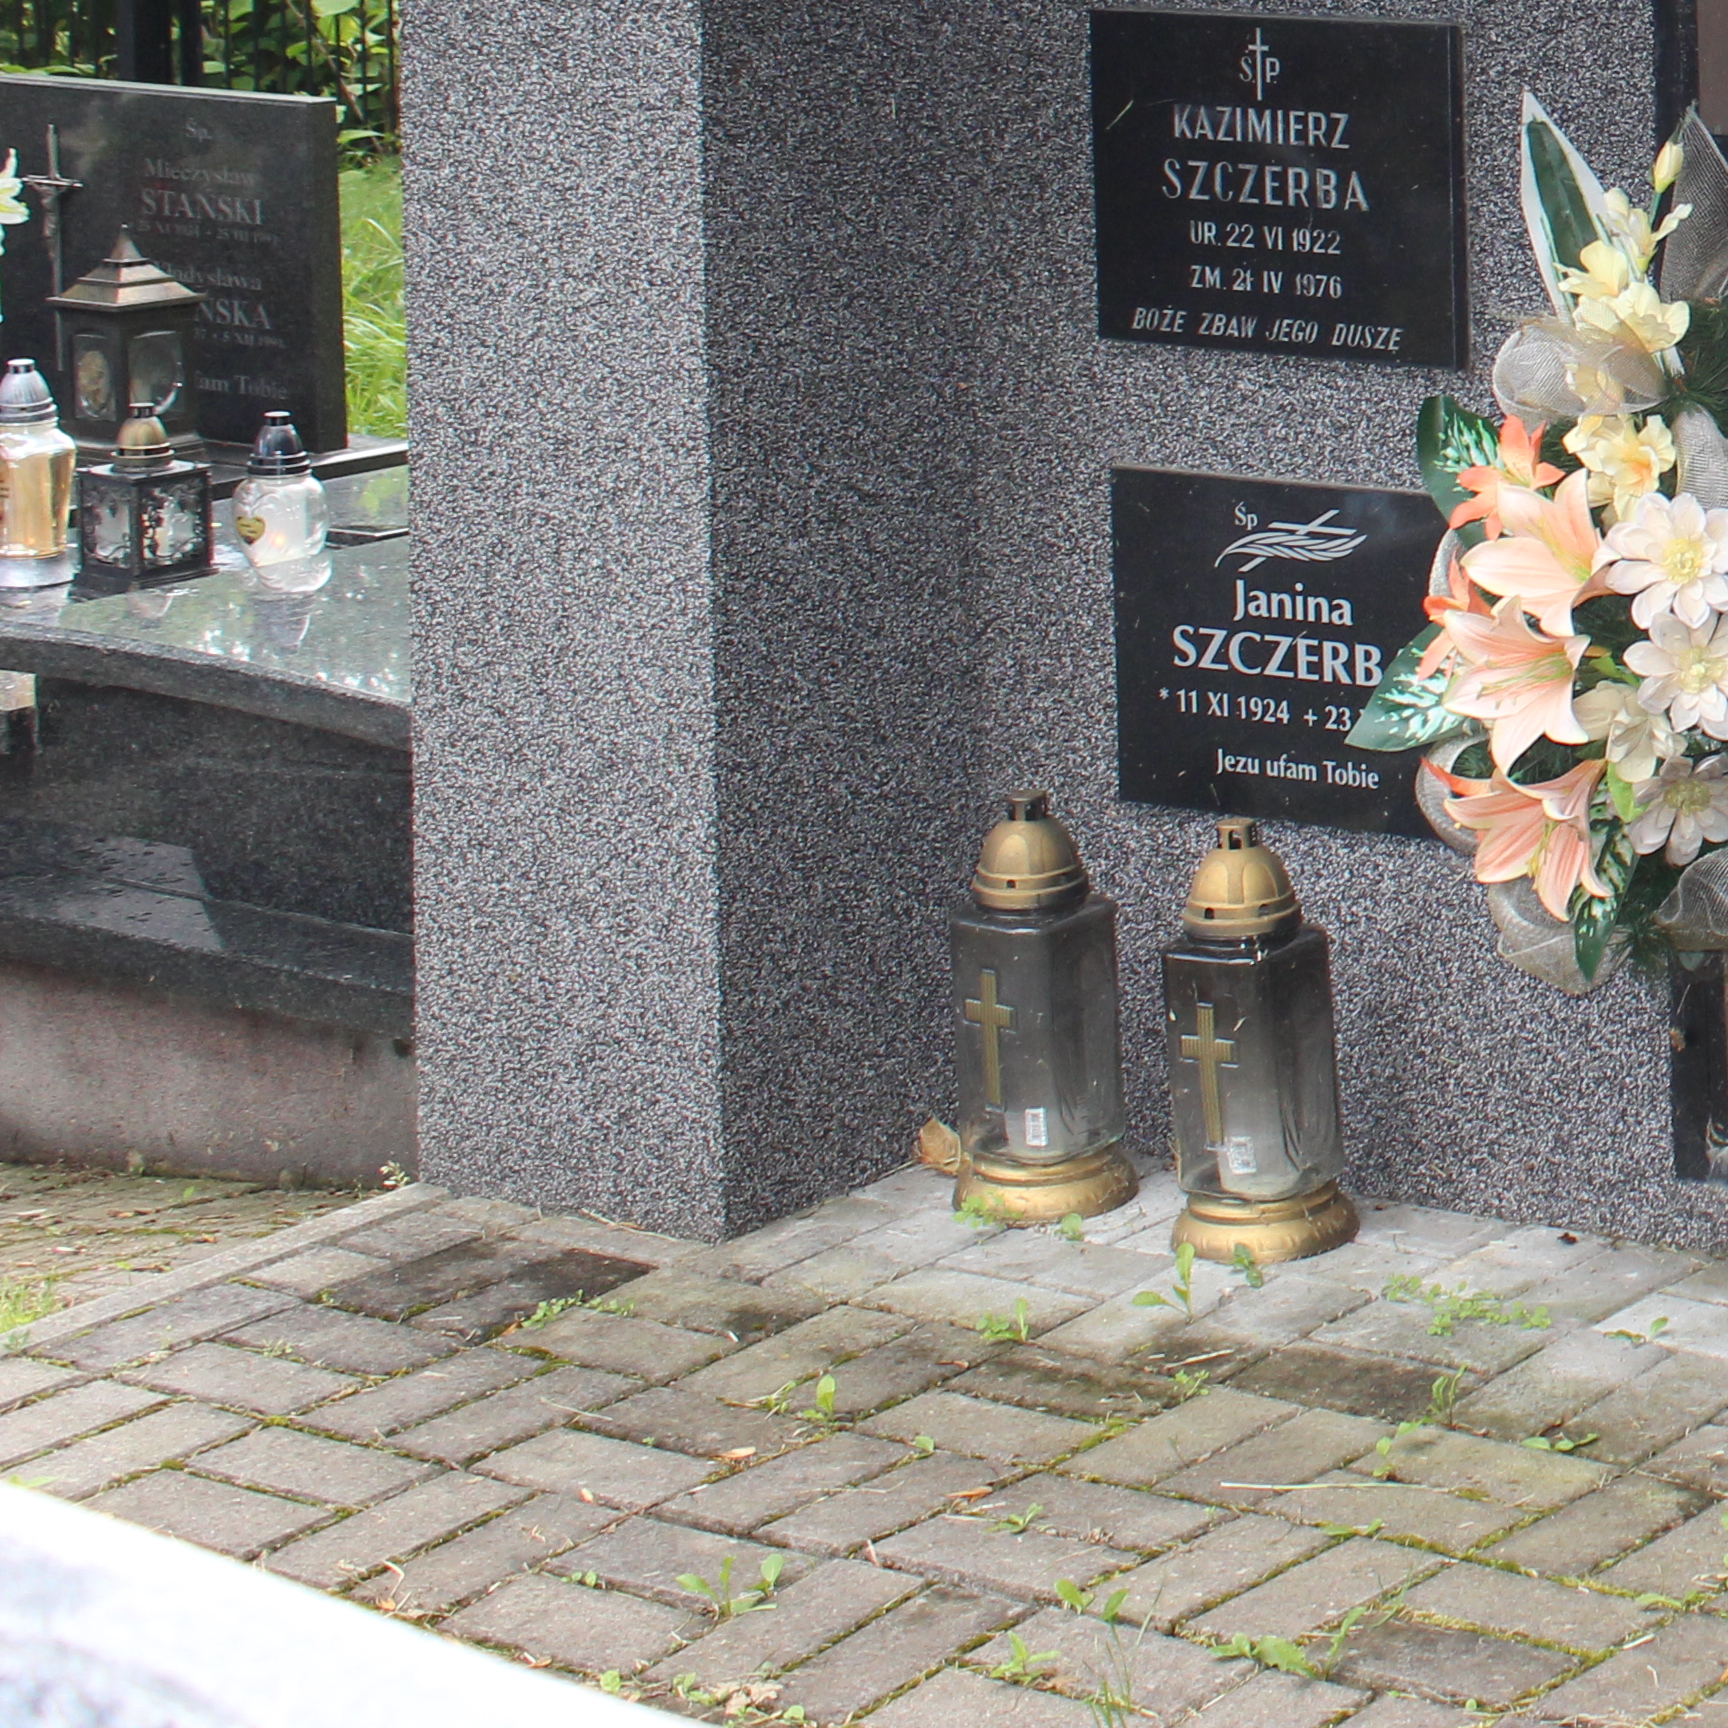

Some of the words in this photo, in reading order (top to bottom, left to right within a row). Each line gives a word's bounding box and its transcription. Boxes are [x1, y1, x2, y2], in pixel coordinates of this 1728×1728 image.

[1174, 104, 1350, 149] KAZIMIERZ
[1162, 158, 1369, 212] SZCZERBA
[1190, 220, 1222, 247] UR.
[1226, 222, 1255, 249] 22
[1263, 225, 1283, 251] VI
[1292, 228, 1341, 255] 1922
[1191, 265, 1228, 291] ZM.
[1263, 270, 1283, 294] IV
[1295, 273, 1342, 299] 1976
[1131, 304, 1187, 333] BOŻE
[1198, 312, 1257, 339] ZBAW
[1265, 318, 1318, 344] JEGO
[1234, 501, 1258, 531] Śp
[1233, 579, 1354, 626] Janina
[1171, 624, 1383, 686] SZCZERB
[1176, 688, 1198, 714] 11
[1207, 691, 1229, 717] XI
[1237, 695, 1290, 725] 1924
[1324, 705, 1353, 732] 23
[1216, 748, 1260, 775] Jezu
[1266, 755, 1317, 782] ufam
[1322, 760, 1379, 790] Tobie
